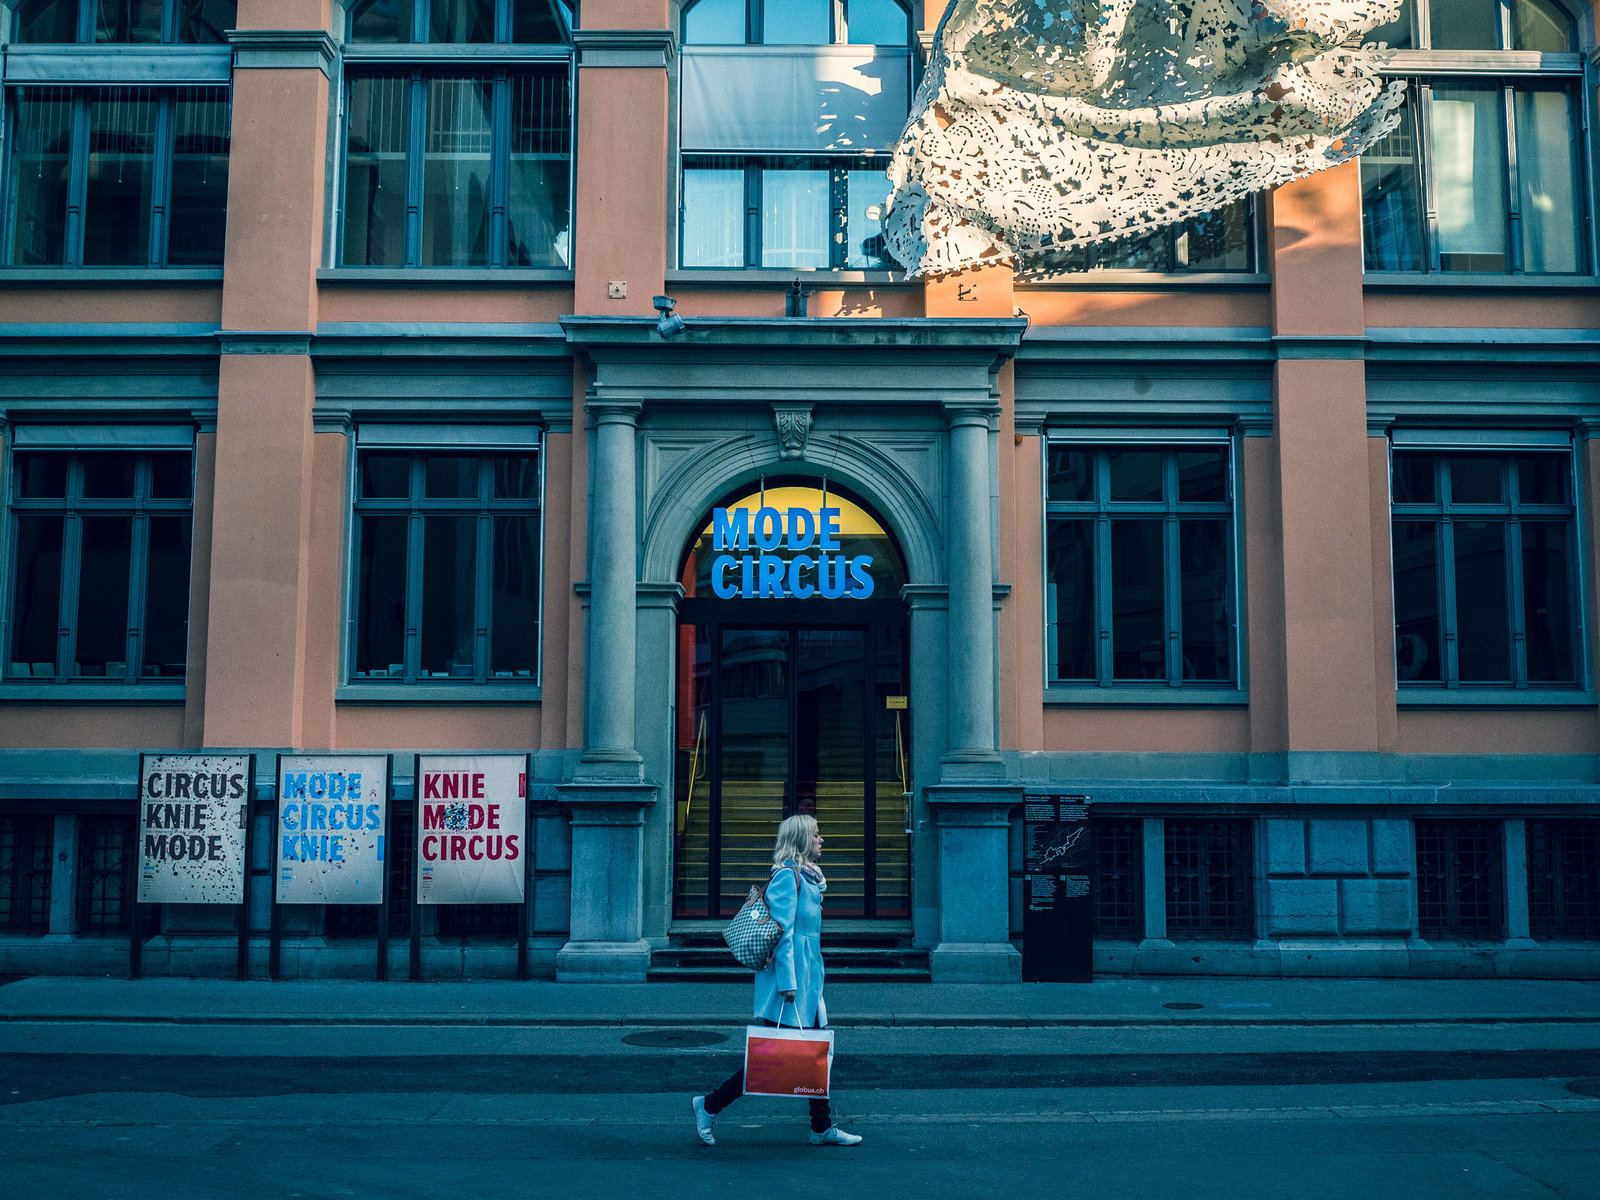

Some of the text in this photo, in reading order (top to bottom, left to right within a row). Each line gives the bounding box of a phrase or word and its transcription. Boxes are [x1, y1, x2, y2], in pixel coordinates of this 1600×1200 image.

[713, 507, 841, 551] MODE
[711, 555, 875, 599] CIRCUS
[146, 773, 243, 800] CIRCUS
[283, 773, 362, 799] MODE
[424, 773, 485, 799] KNIE
[146, 805, 207, 831] KNIE
[282, 804, 381, 831] CIRCUS
[423, 804, 501, 830] MDE
[144, 836, 222, 861] MODE
[282, 835, 343, 862] KNIE
[422, 834, 519, 862] CIRCUS
[793, 1086, 825, 1094] globus.ch
